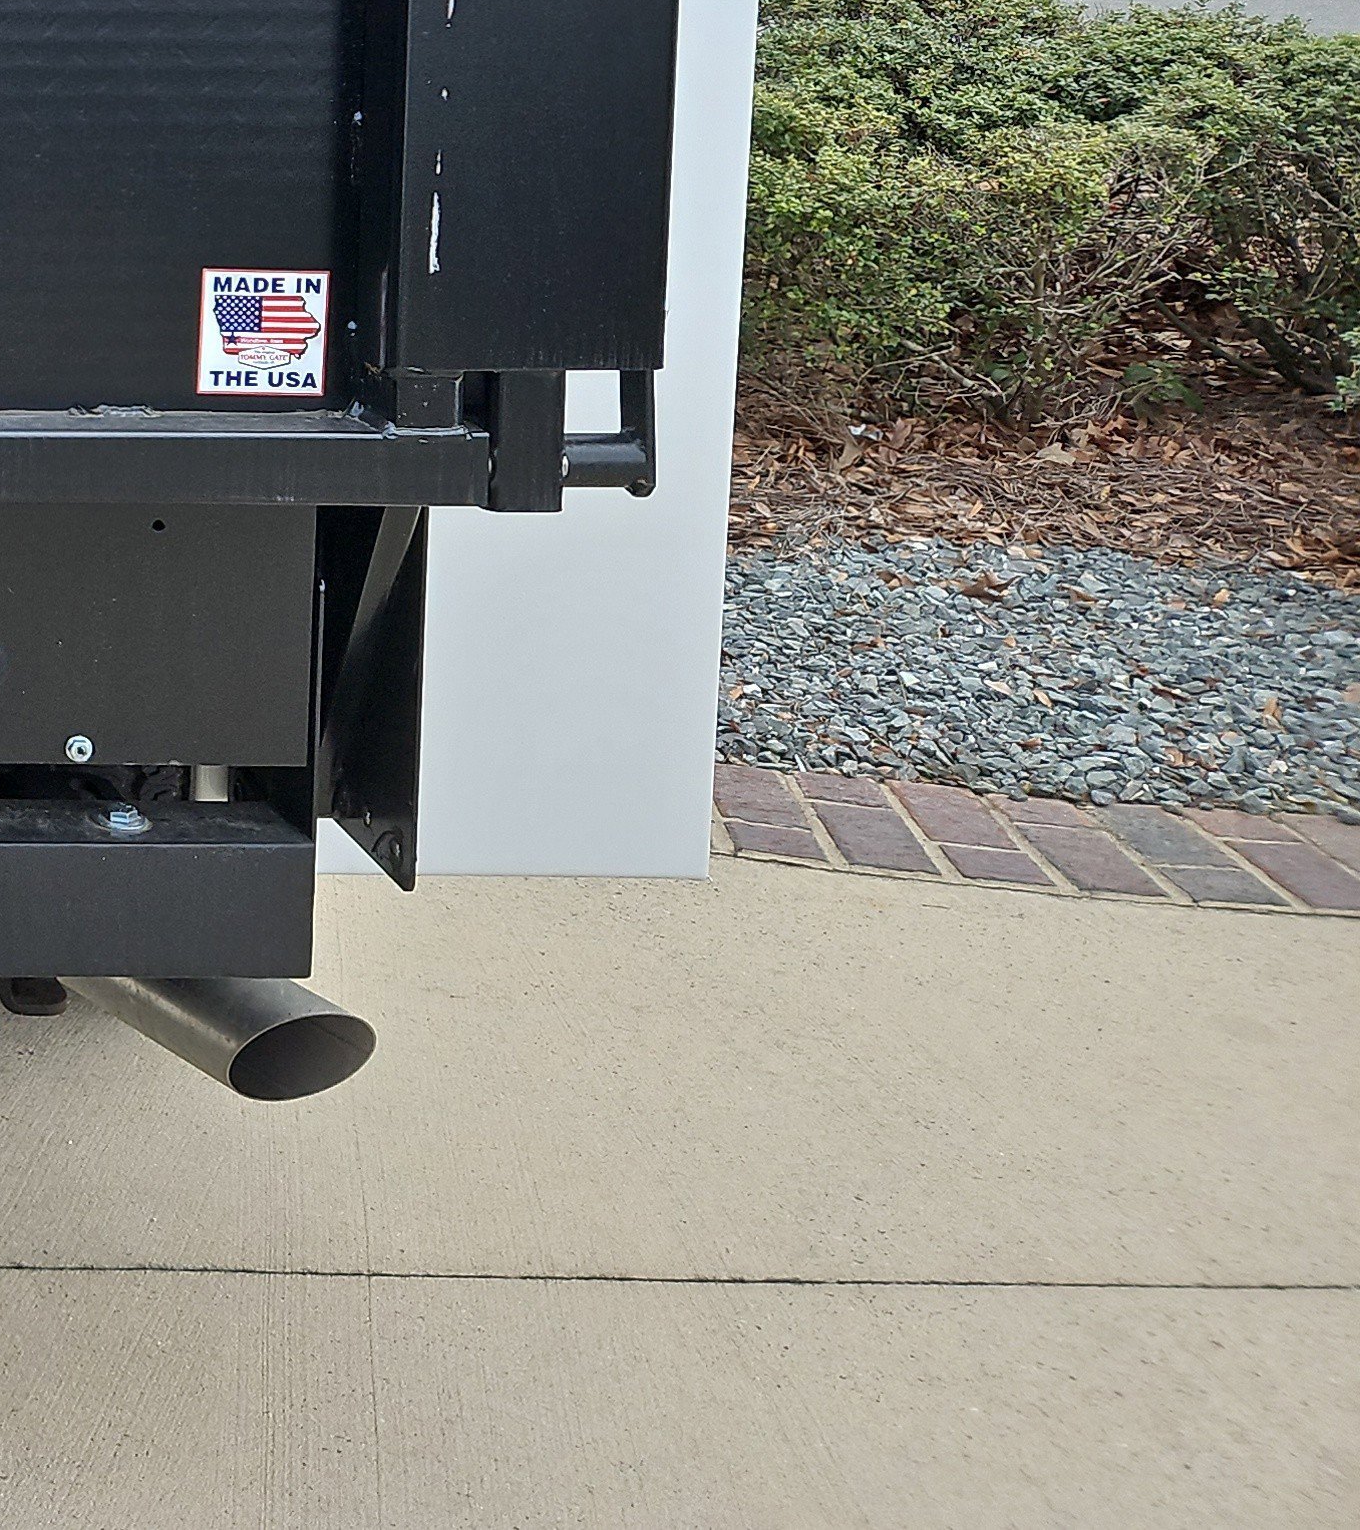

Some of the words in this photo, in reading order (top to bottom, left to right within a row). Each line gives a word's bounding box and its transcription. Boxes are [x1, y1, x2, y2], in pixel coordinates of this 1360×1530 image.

[213, 277, 285, 293] MADE
[296, 278, 321, 294] IN
[209, 371, 258, 387] THE
[268, 372, 317, 388] USA
